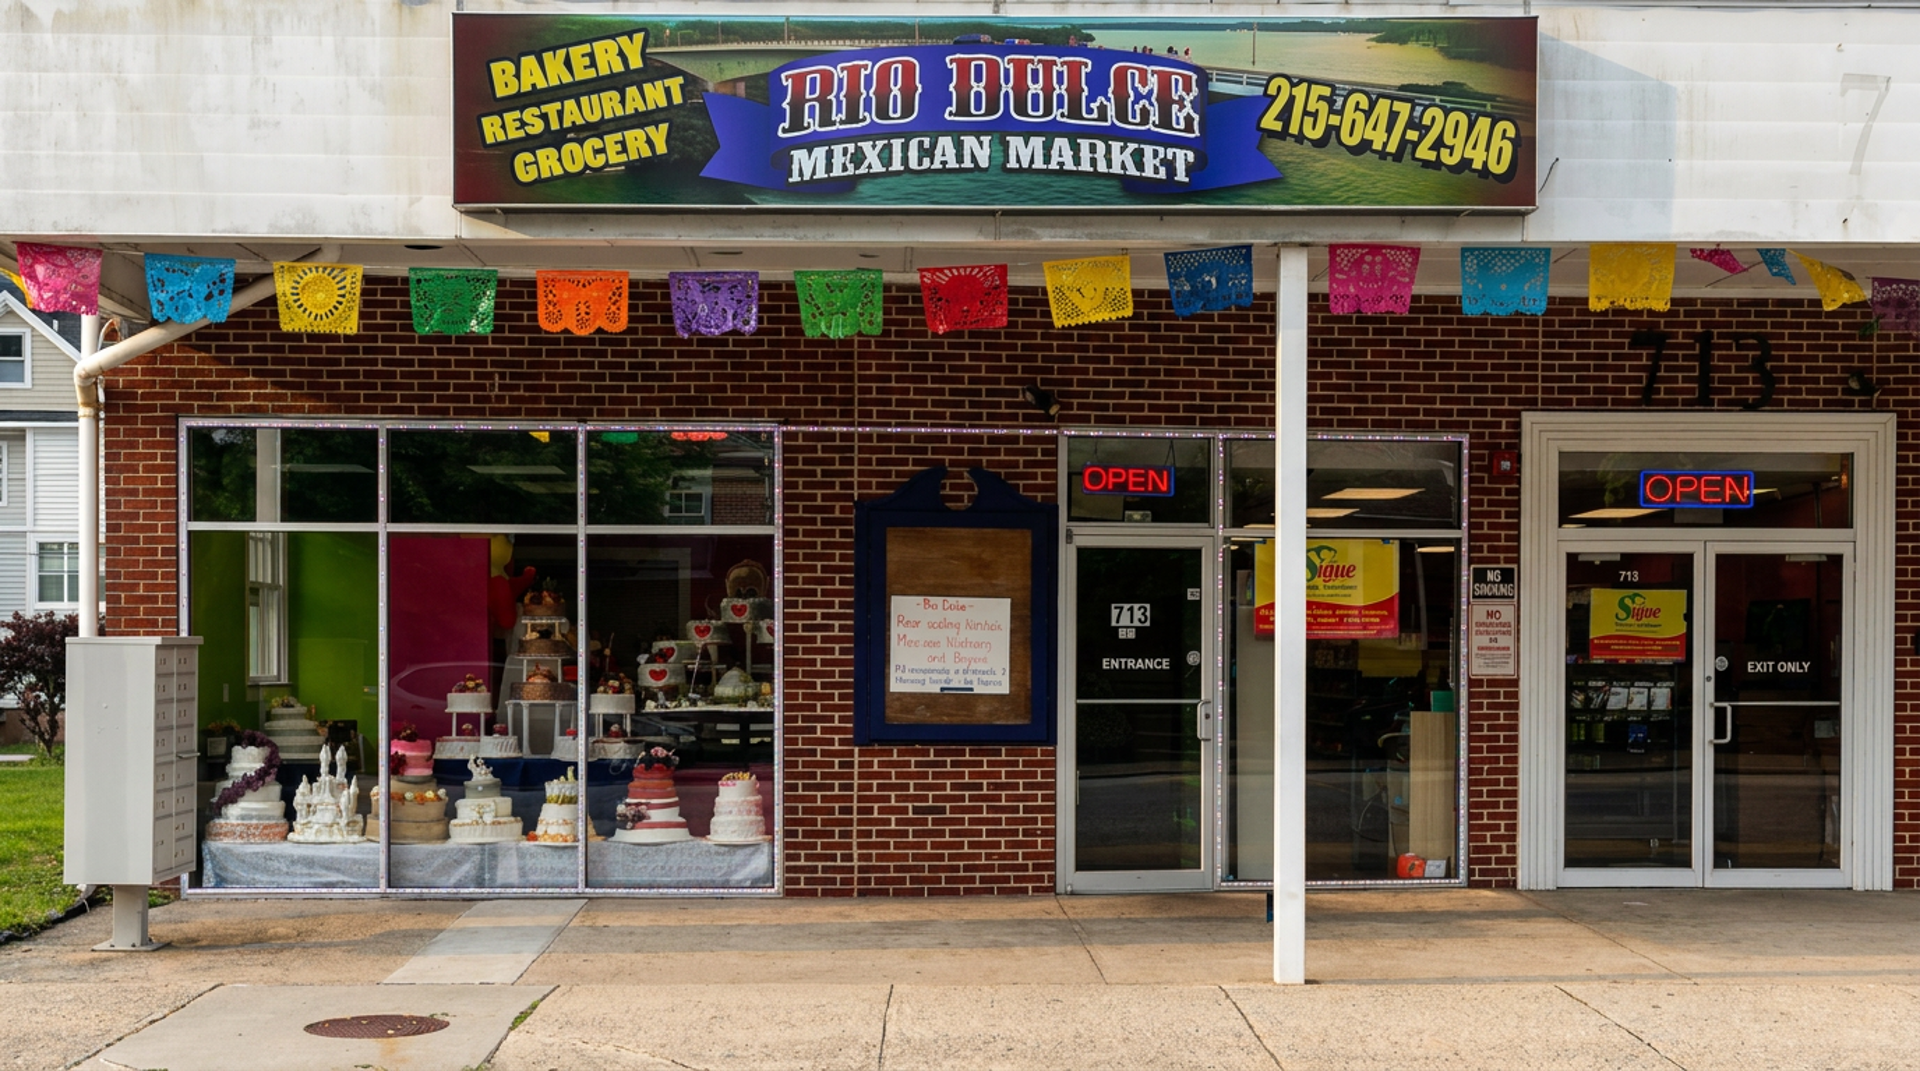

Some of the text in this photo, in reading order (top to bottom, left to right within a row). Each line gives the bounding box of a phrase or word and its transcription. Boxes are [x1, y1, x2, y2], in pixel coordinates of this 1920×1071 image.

[489, 31, 647, 98] BAKERY
[480, 76, 685, 145] RESTAURANT
[777, 51, 1201, 138] RIO DULCE
[1257, 76, 1516, 175] 215-647-2946
[513, 123, 670, 184] GROCERY
[787, 135, 1195, 184] MEXICAN MARKET
[1629, 330, 1775, 410] 713
[1083, 466, 1169, 492] OPEN
[1646, 475, 1749, 503] OPEN
[1619, 571, 1639, 581] 713
[1113, 605, 1148, 624] 713
[1486, 610, 1502, 620] NO
[1102, 658, 1170, 669] ENTRANCE
[1747, 661, 1811, 673] EXIT ONLY
